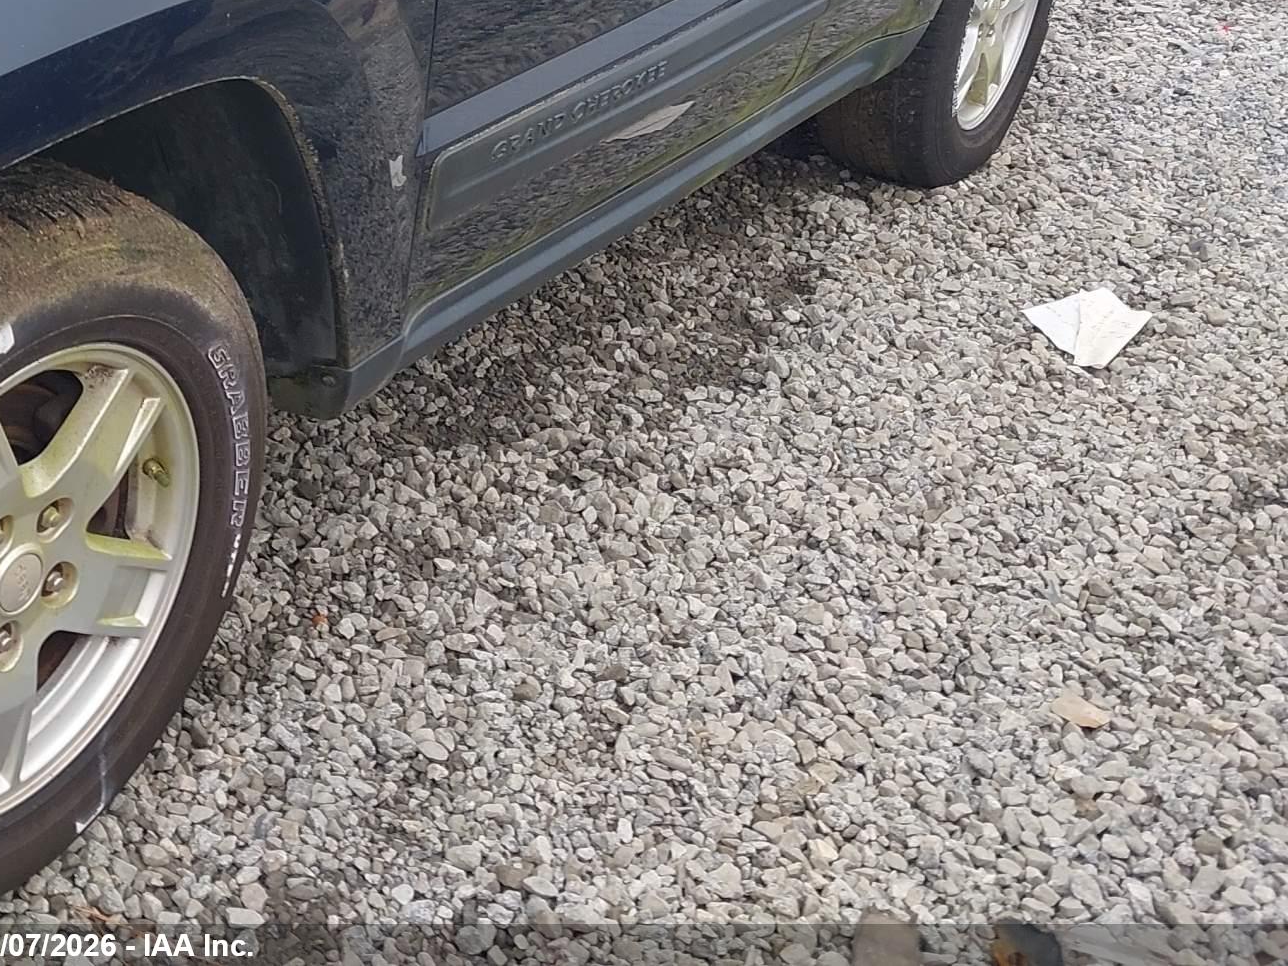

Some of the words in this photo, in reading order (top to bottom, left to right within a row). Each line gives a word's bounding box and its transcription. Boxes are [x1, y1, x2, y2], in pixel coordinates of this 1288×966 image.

[491, 113, 565, 161] GRAND
[571, 60, 668, 124] CHEROKEE
[207, 344, 252, 527] GRABBER
